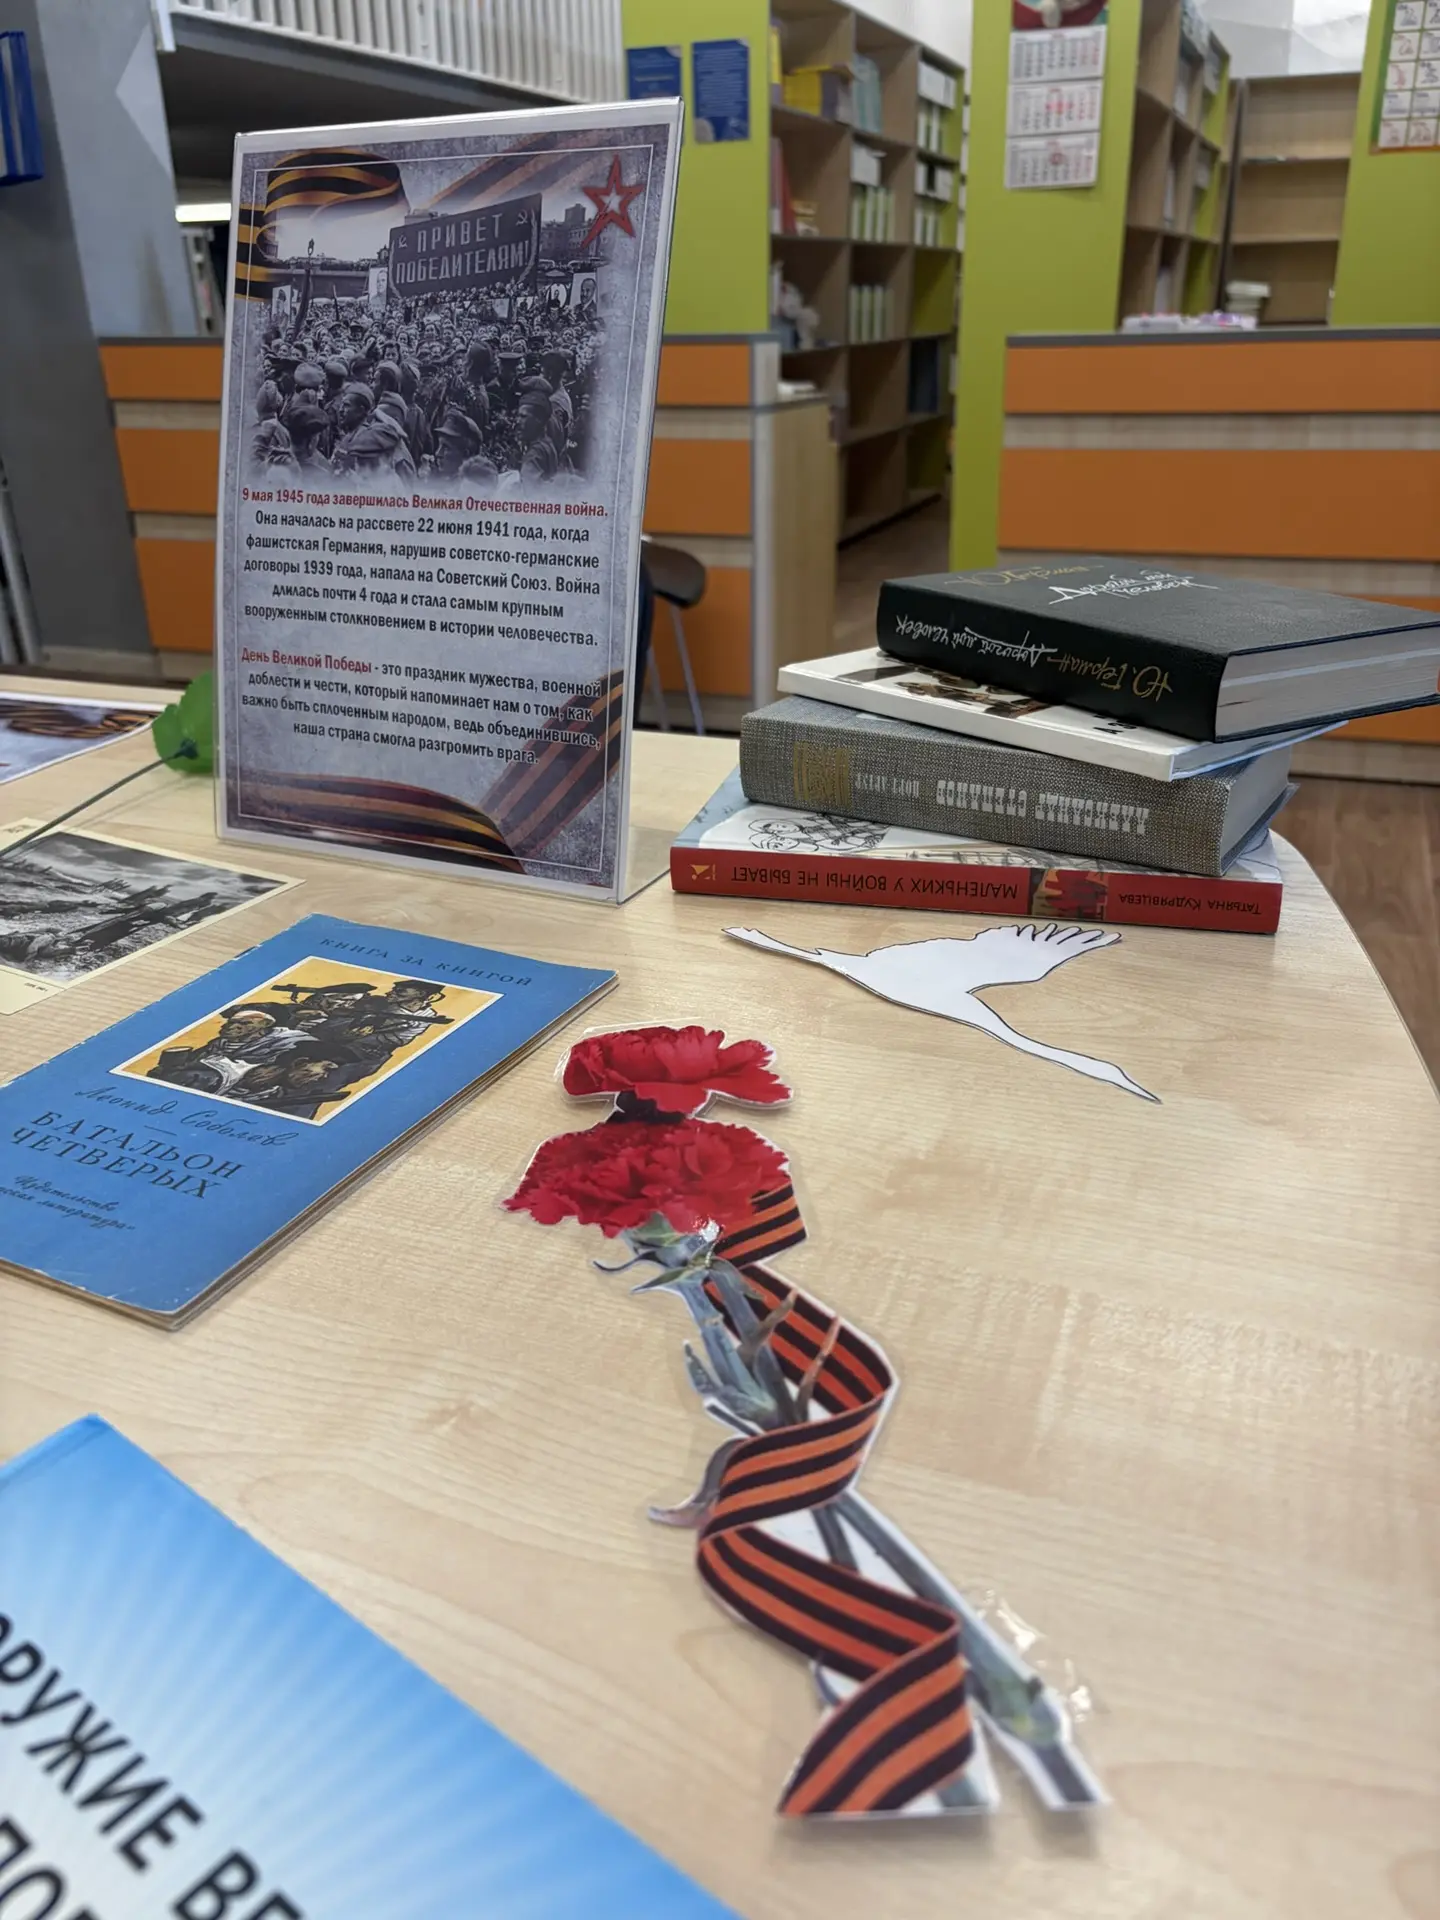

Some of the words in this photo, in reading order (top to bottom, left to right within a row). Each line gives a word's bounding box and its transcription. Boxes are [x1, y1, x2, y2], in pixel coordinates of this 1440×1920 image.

[417, 213, 502, 253] ПРИВЕТ
[396, 240, 529, 284] ПОБЕДИТЕЛЯМ!
[242, 488, 249, 501] 9
[252, 491, 273, 502] мая
[276, 489, 304, 503] 1945
[306, 493, 330, 505] года
[332, 494, 409, 508] завершилась
[412, 494, 463, 510] Великая
[466, 496, 561, 515] Отечественная
[564, 501, 608, 517] война.
[255, 510, 278, 525] Она
[281, 514, 336, 528] началась
[339, 517, 354, 529] на
[356, 518, 415, 532] рассвете
[417, 517, 434, 533] 22
[437, 522, 473, 535] июня
[476, 520, 510, 537] 1941
[513, 526, 547, 542] года,
[551, 527, 590, 543] когда
[246, 534, 319, 551] фашистская
[322, 537, 387, 558] Германия,
[390, 544, 446, 560] нарушив
[449, 547, 600, 568] советско-германские
[244, 559, 300, 575] договоры
[303, 560, 333, 575] 1939
[336, 564, 367, 580] года,
[370, 567, 415, 582] напала
[418, 570, 433, 582] на
[436, 568, 508, 588] Советский
[511, 573, 551, 591] Союз.
[555, 576, 600, 595] Война
[272, 584, 320, 599] длилась
[323, 588, 357, 602] почти
[359, 587, 367, 601] 4
[370, 591, 397, 606] года
[400, 594, 409, 605] и
[411, 594, 447, 608] стала
[449, 597, 499, 612] самым
[502, 601, 564, 618] крупным
[244, 605, 327, 622] вооруженным
[330, 611, 426, 630] столкновением
[429, 621, 437, 631] в
[440, 622, 495, 638] истории
[498, 627, 599, 646] человечества.
[952, 633, 978, 649] мой
[978, 630, 1058, 668] Дорогой
[241, 648, 270, 663] День
[272, 650, 322, 668] Великой
[325, 655, 372, 673] Победы
[381, 663, 402, 677] это
[404, 666, 466, 683] праздник
[469, 673, 538, 693] мужества,
[542, 679, 601, 697] военной
[1047, 653, 1128, 690] Герман
[248, 671, 301, 689] доблести
[303, 679, 311, 689] и
[314, 681, 351, 695] чести,
[354, 683, 408, 701] который
[410, 691, 489, 709] напоминает
[493, 700, 520, 713] нам
[523, 703, 531, 714] о
[533, 703, 564, 719] том,
[567, 707, 593, 722] как
[242, 694, 278, 709] важно
[280, 696, 311, 713] быть
[313, 703, 389, 722] сплоченным
[392, 713, 450, 731] народом,
[453, 719, 484, 734] ведь
[487, 720, 601, 751] объединившись,
[293, 722, 325, 736] наша
[328, 726, 370, 742] страна
[373, 732, 416, 747] смогла
[419, 737, 494, 758] разгромить
[497, 748, 539, 764] врага.
[936, 780, 1027, 818] СТЕПАНОВ
[1035, 792, 1149, 835] АЛЕКСАНДР
[731, 866, 791, 885] БЫВАЕТ
[798, 870, 819, 887] НЕ
[826, 872, 887, 892] ВОЙНЫ
[893, 877, 904, 892] У
[911, 878, 1018, 900] МАЛЕНЬКИХ
[320, 938, 389, 959] КНИГА
[400, 955, 424, 966] ЗА
[435, 962, 533, 986] КНИГОЙ
[74, 1086, 179, 1116] Леонид
[180, 1110, 299, 1147] Соболев
[11, 1127, 222, 1200] ЧЕТВЕРЫХ
[31, 1111, 246, 1179] БАТАЛЬОН
